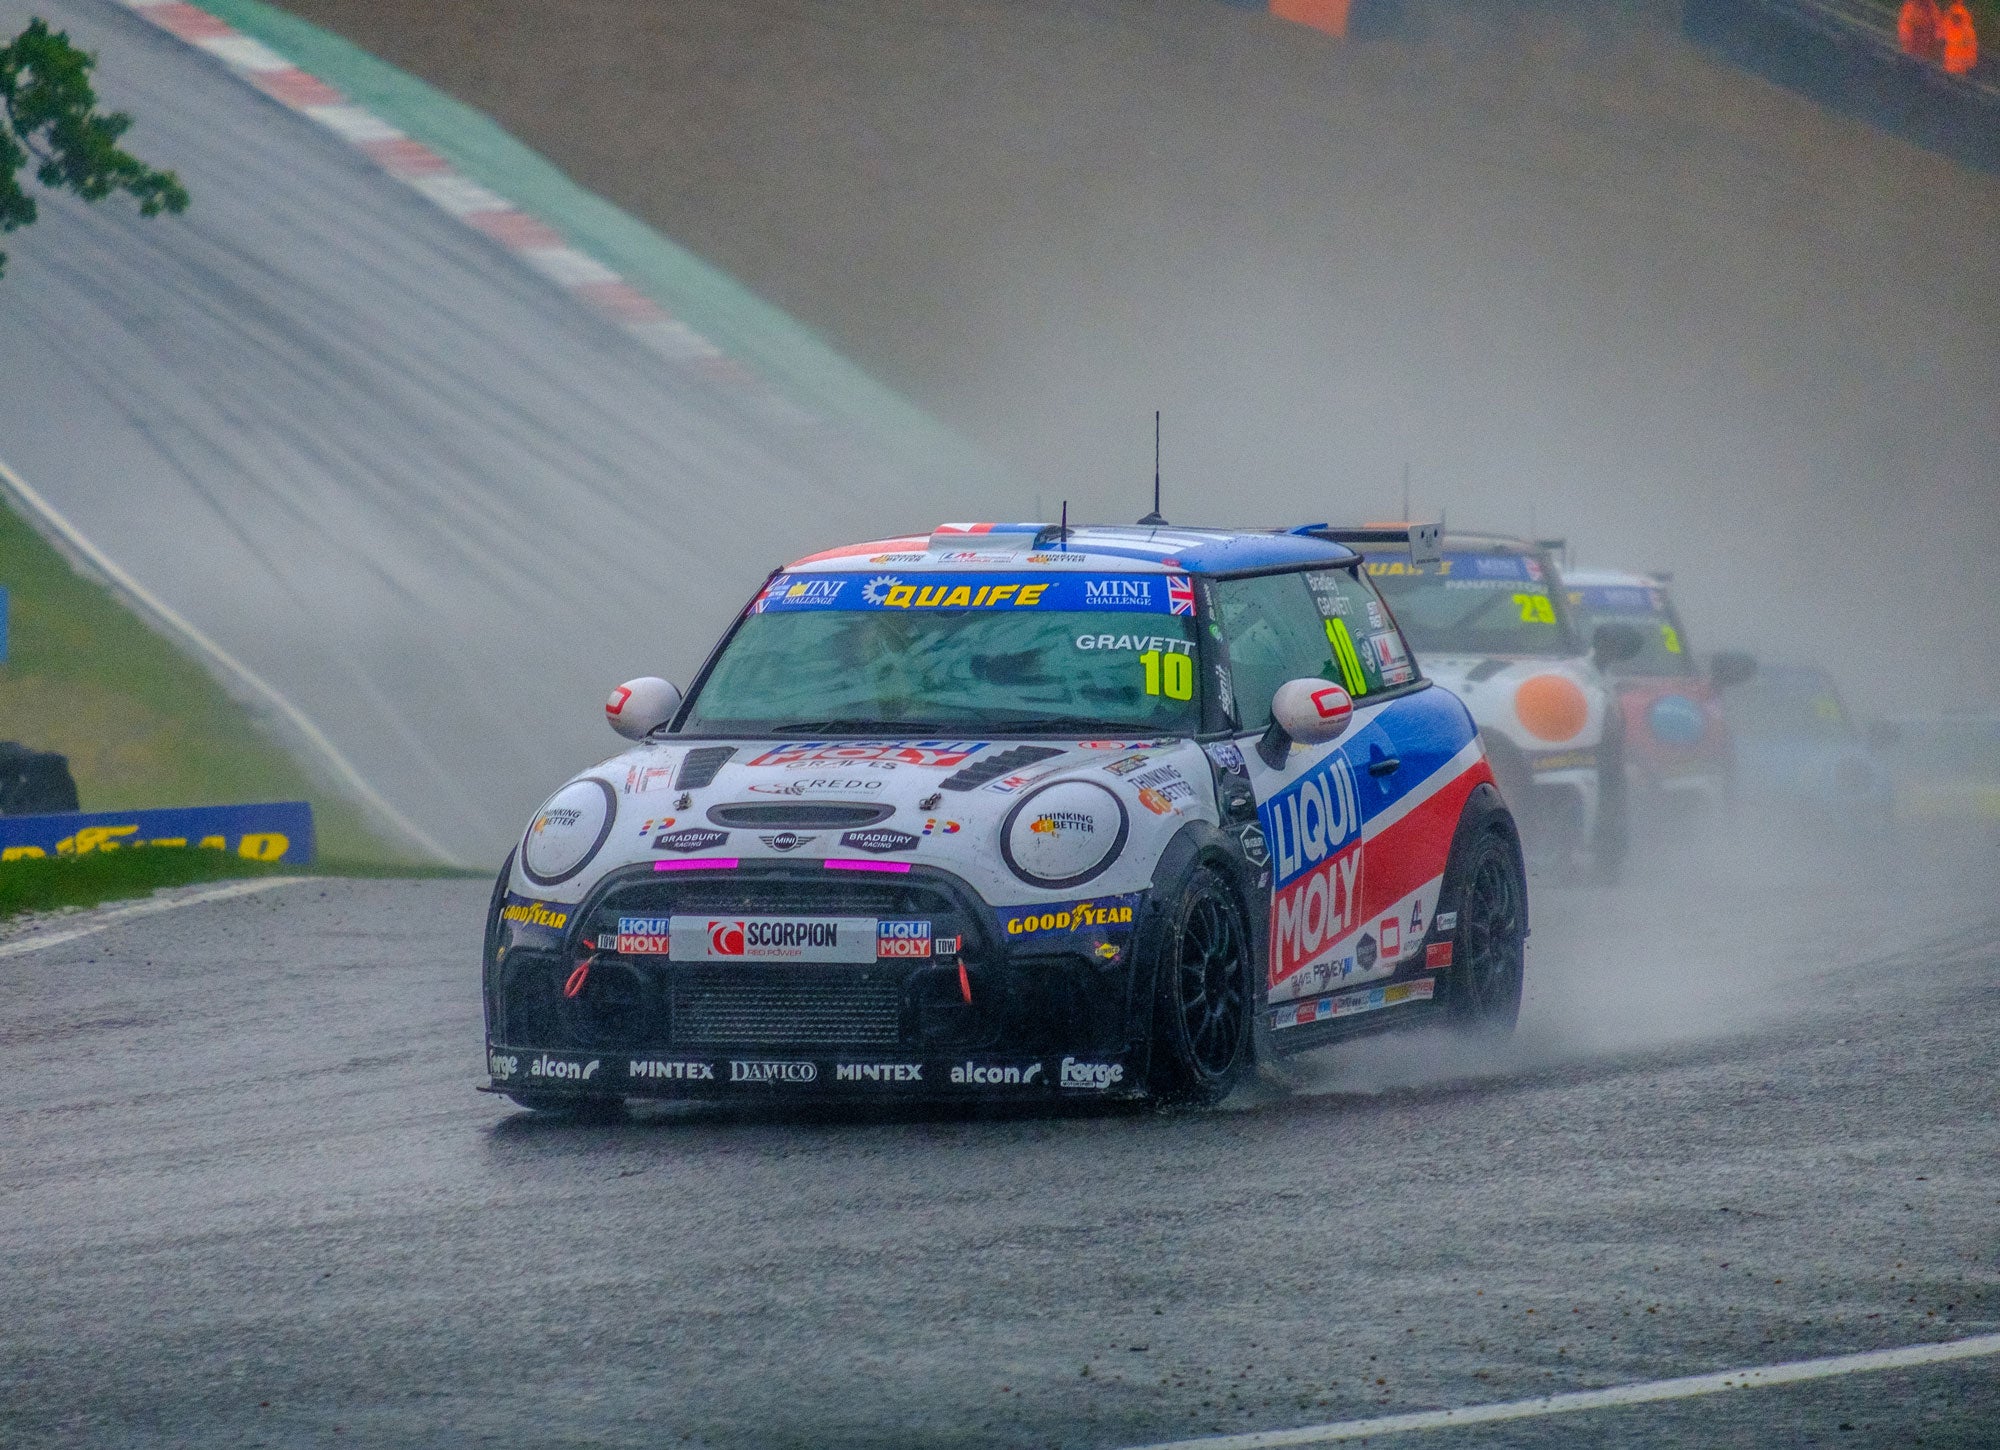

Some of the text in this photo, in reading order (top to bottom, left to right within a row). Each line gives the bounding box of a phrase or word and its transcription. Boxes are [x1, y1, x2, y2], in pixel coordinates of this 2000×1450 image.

[884, 583, 1049, 608] QUAIFE
[1085, 580, 1151, 598] MINI
[1086, 597, 1151, 606] CHALLENGE
[1076, 634, 1196, 656] GRAVETT
[1325, 617, 1368, 696] 10
[1139, 650, 1193, 701] 10
[758, 749, 970, 766] MOLY
[793, 779, 882, 789] CREDO
[1127, 764, 1182, 789] THINKING
[1156, 780, 1196, 803] BETTER
[1037, 812, 1094, 824] THINKING
[1273, 758, 1357, 880] LIQUI
[1052, 821, 1094, 834] BETTER
[661, 833, 722, 843] BRADBURY
[775, 837, 796, 846] MINI
[849, 832, 912, 844] BRADBURY
[862, 841, 892, 849] RACING
[503, 903, 567, 929] GOODYEAR
[1007, 903, 1133, 935] GOODYEAR
[1275, 847, 1362, 975] MOLY
[620, 919, 666, 935] LIQUI
[747, 922, 838, 947] SCORPION
[880, 922, 929, 938] LIQUI
[600, 936, 617, 949] TOW
[620, 936, 667, 951] MOLY
[880, 940, 928, 954] MOLY
[938, 940, 955, 953] TOW
[531, 1054, 581, 1079] alcon
[629, 1060, 714, 1079] MINTEX
[836, 1064, 923, 1081] MINTEX
[951, 1062, 1020, 1083] alcon
[1060, 1057, 1124, 1088] forge
